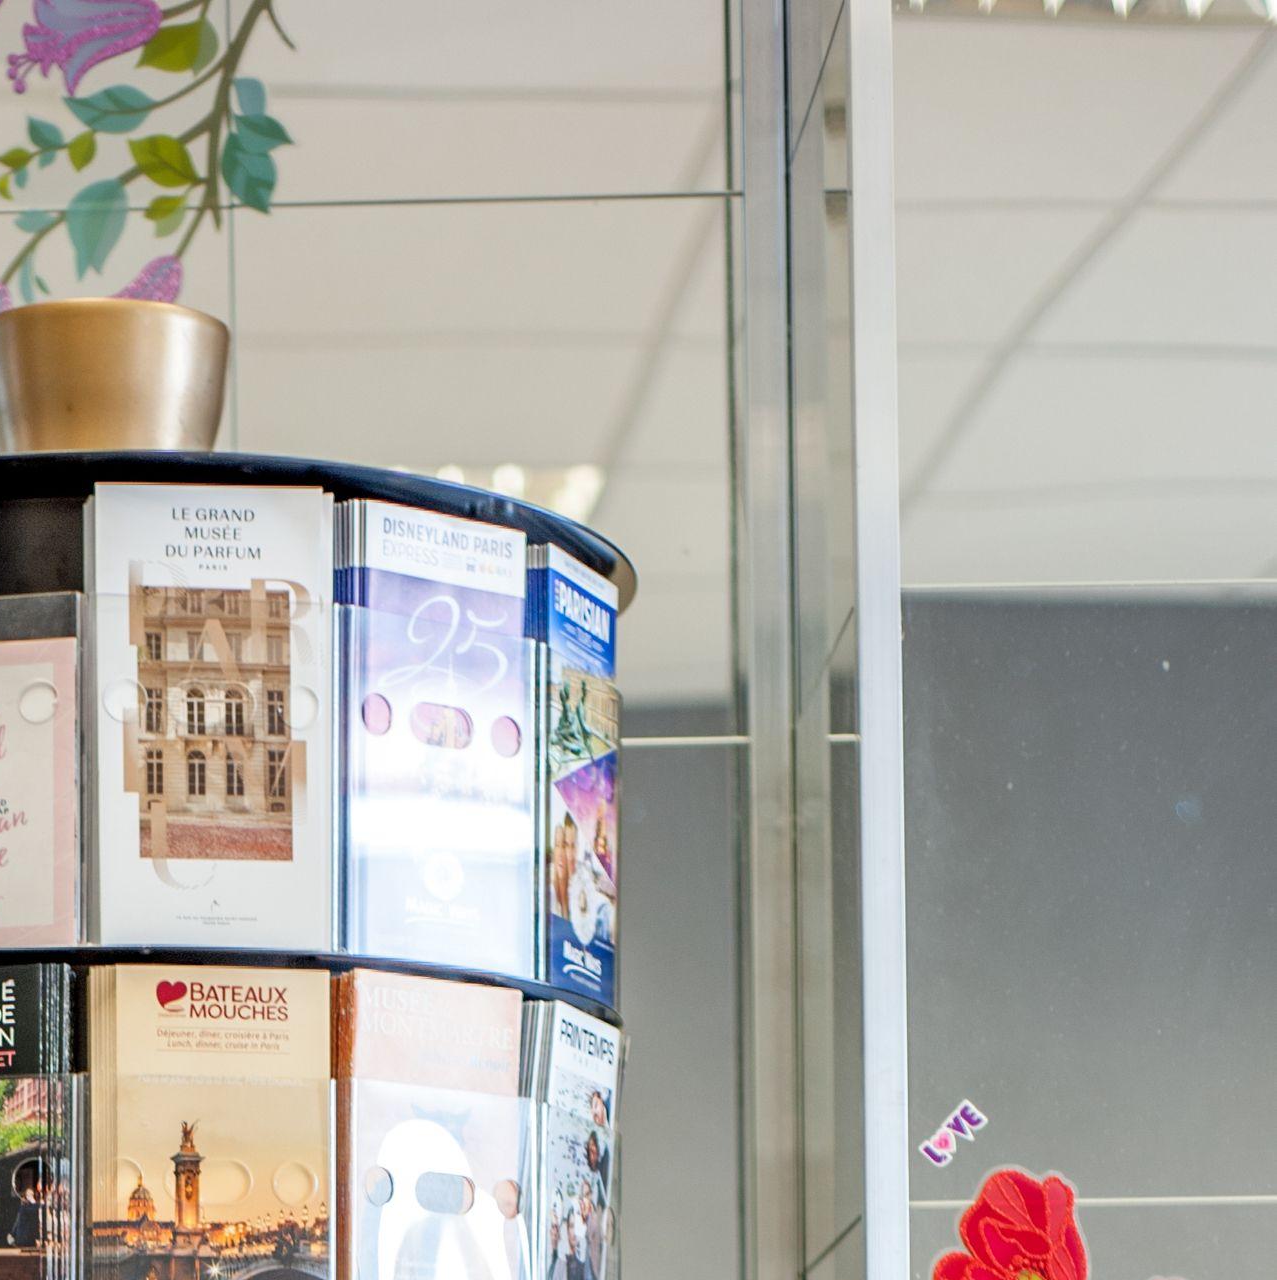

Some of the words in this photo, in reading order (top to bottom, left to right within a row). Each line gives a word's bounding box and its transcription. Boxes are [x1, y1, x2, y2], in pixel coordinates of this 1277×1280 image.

[172, 507, 192, 522] LE
[196, 507, 256, 523] GRAND
[185, 523, 242, 541] MUSÉE
[383, 517, 469, 551] DISNEYLAND
[474, 536, 513, 559] PARIS
[165, 544, 188, 559] DU
[192, 544, 262, 560] PARFUM
[559, 579, 610, 644] PARISIAN
[190, 982, 288, 1004] BATEAUX
[189, 1004, 289, 1022] MOUCHES
[561, 1018, 615, 1065] PRINTEMPS
